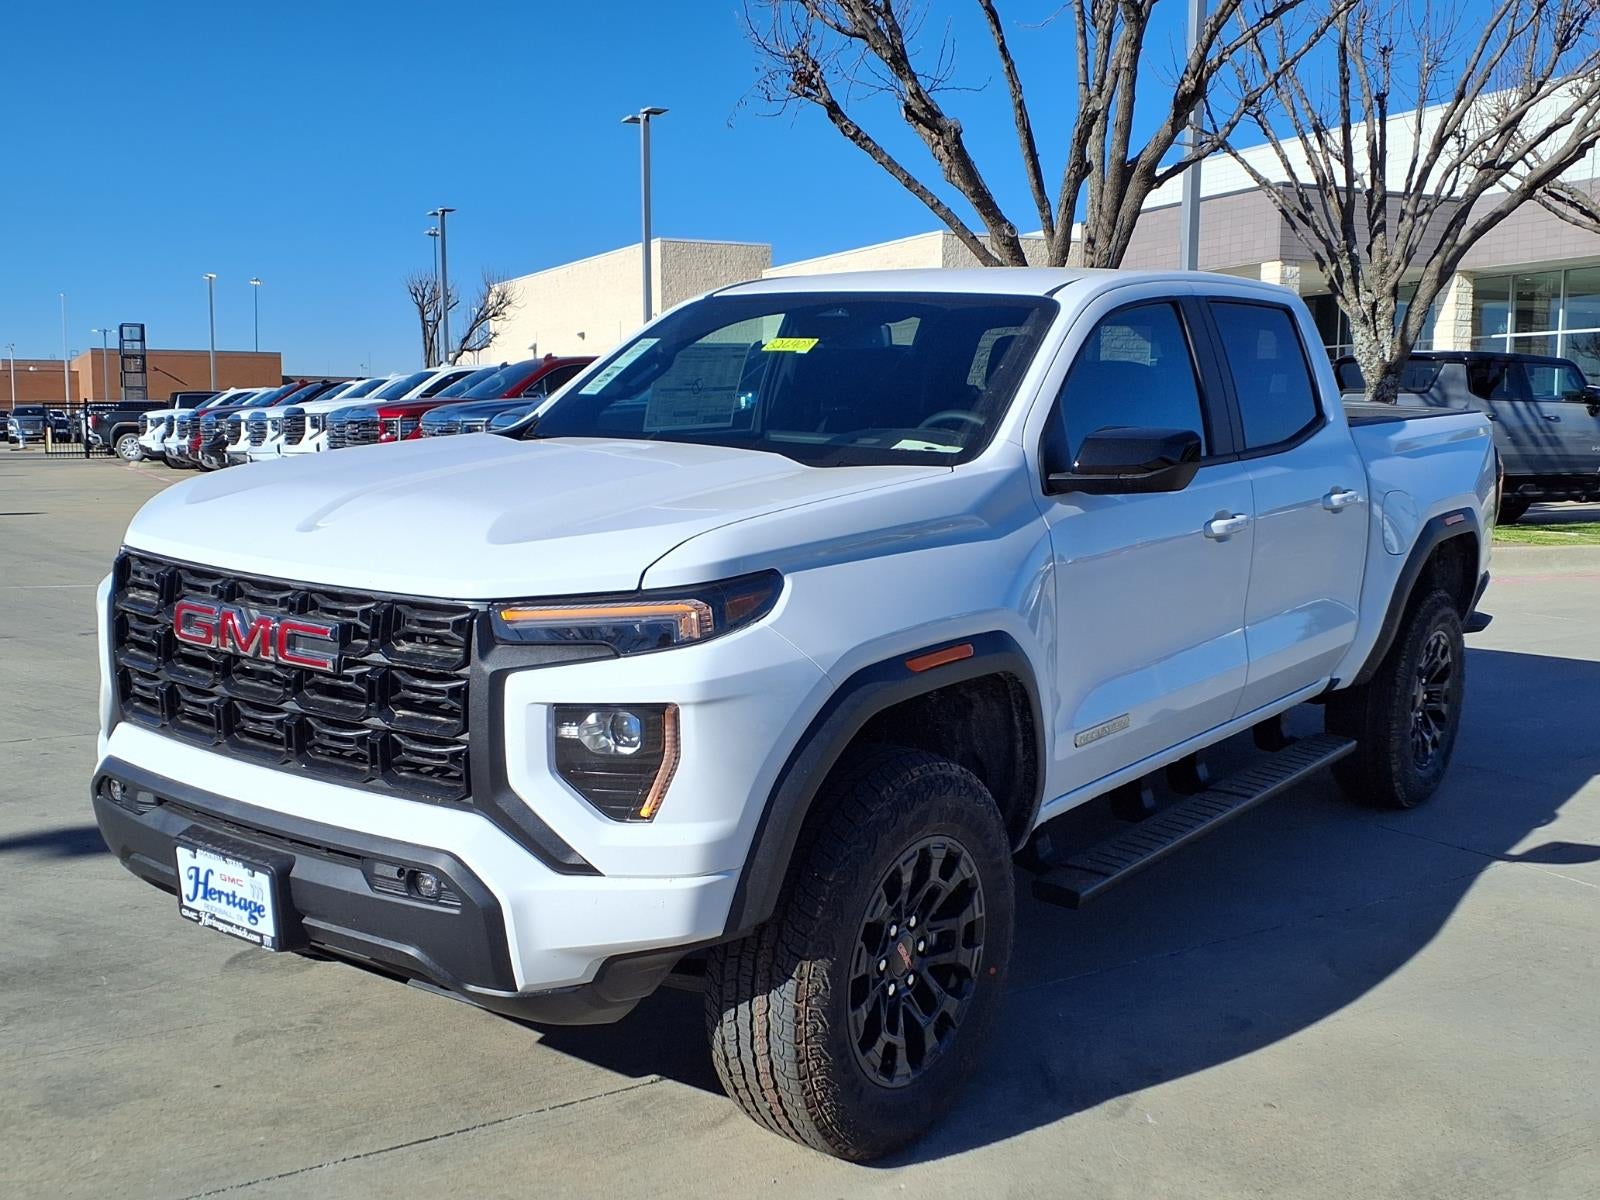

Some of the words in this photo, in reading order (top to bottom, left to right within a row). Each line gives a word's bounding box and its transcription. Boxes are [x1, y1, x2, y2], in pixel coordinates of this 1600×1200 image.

[173, 598, 338, 672] GMC
[185, 865, 266, 926] Heritage
[219, 873, 244, 887] GMC
